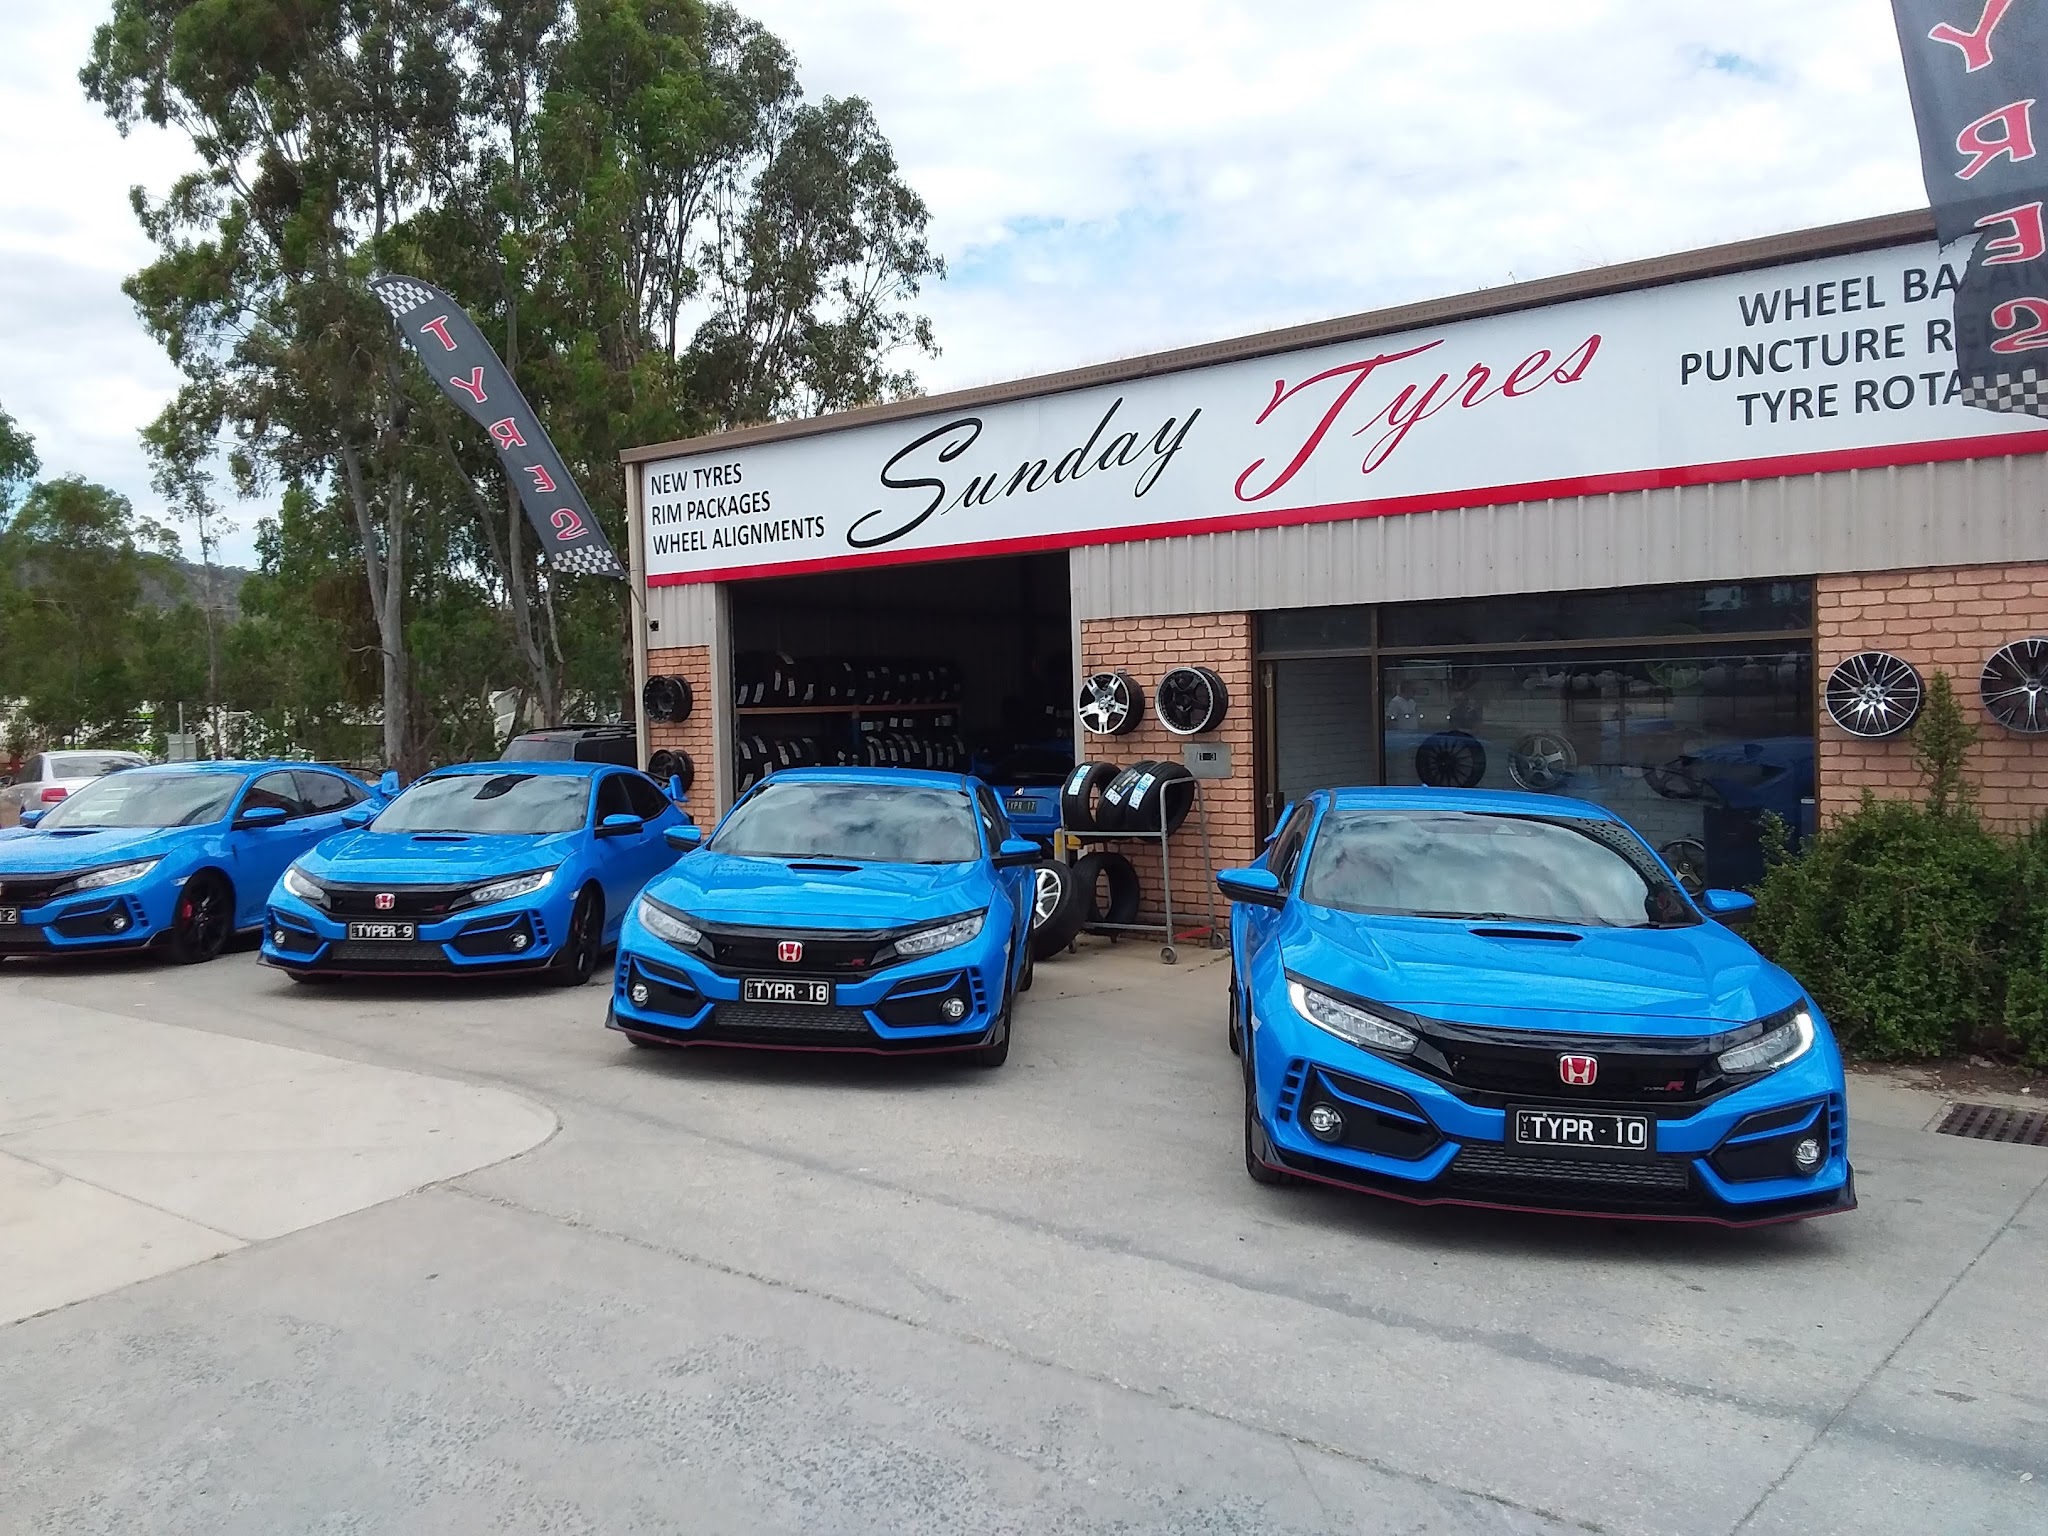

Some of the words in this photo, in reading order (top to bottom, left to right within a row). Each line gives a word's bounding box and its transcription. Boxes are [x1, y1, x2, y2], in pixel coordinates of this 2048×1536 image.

[1738, 275, 1886, 327] WHEEL
[1903, 262, 1960, 304] BA
[1680, 322, 1906, 386] PUNCTURE
[1926, 317, 1955, 355] R
[1736, 382, 1839, 426] TYRE
[1854, 369, 1964, 414] ROTA
[847, 397, 1202, 549] Sunday
[1235, 334, 1603, 502] Tyres
[651, 470, 688, 496] NEW
[693, 463, 742, 490] TYRES
[652, 502, 682, 526] RIM
[687, 490, 771, 522] PACKAGES
[653, 530, 707, 555] WHEEL
[712, 515, 825, 549] ALIGNMENTS
